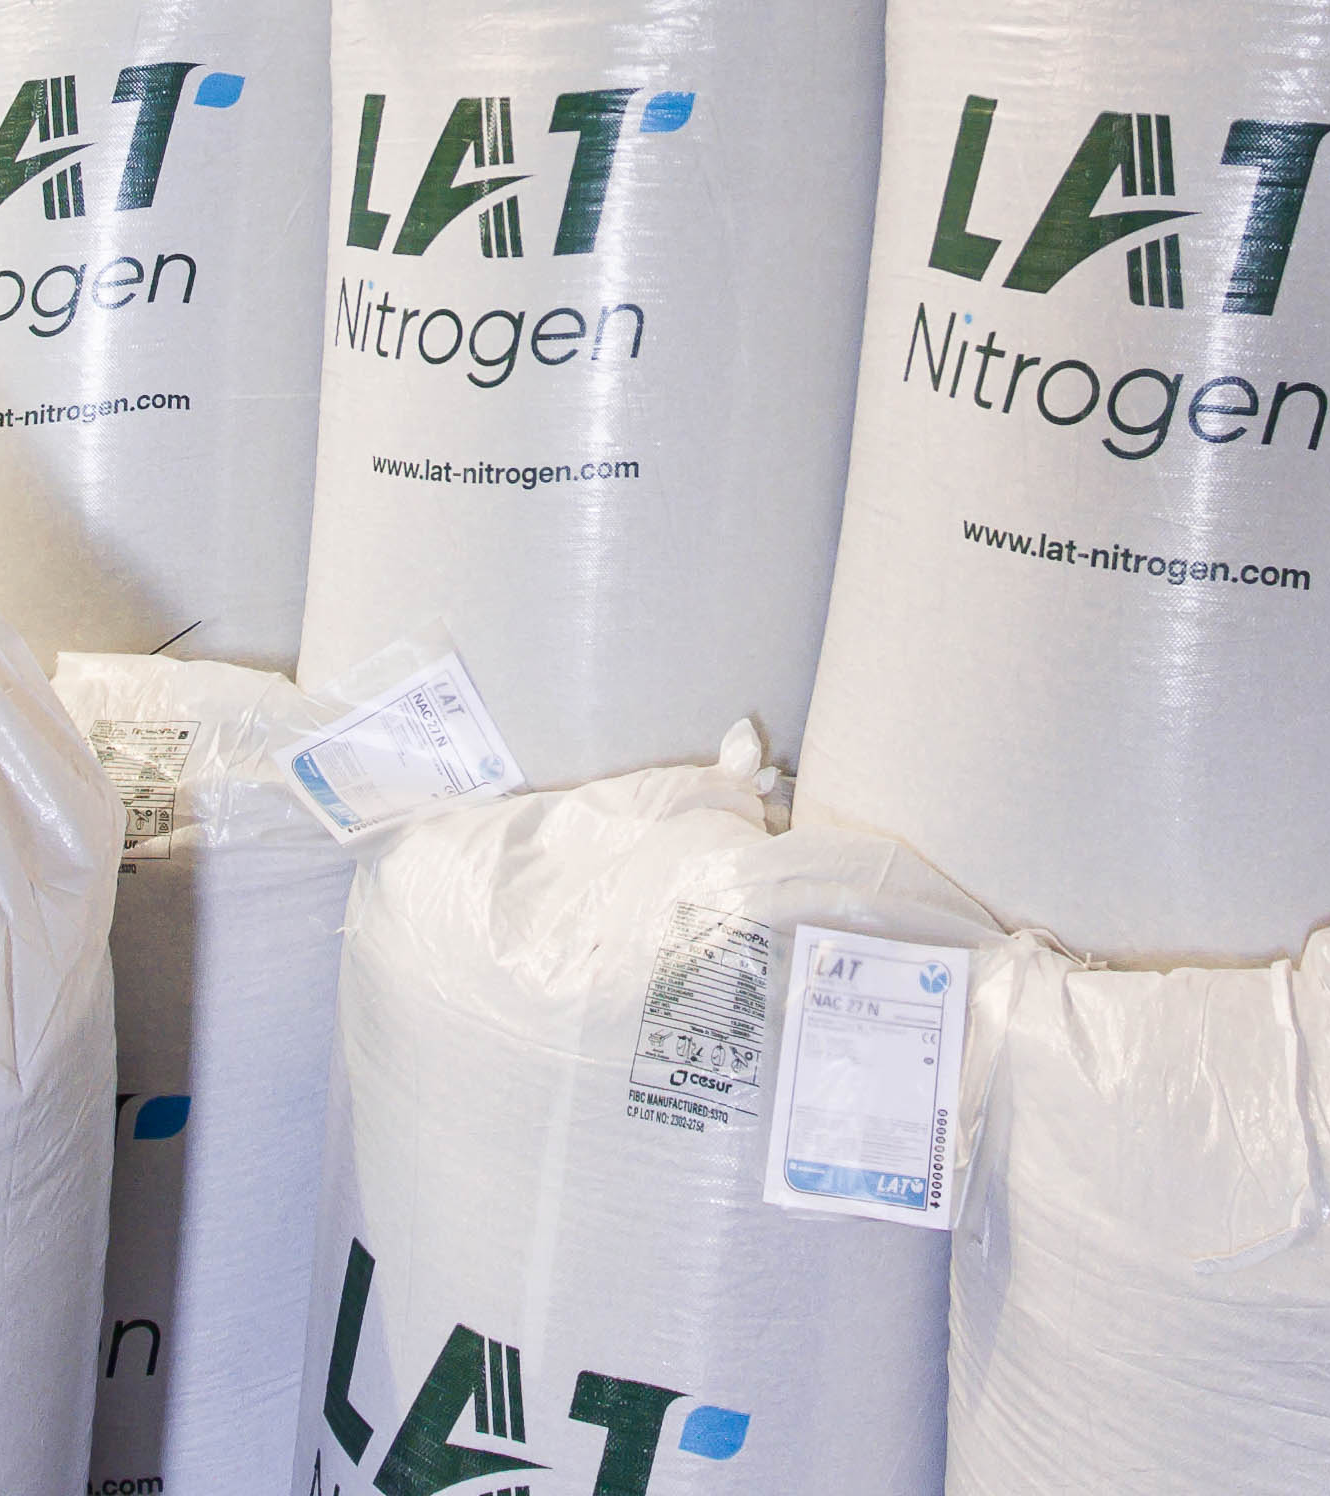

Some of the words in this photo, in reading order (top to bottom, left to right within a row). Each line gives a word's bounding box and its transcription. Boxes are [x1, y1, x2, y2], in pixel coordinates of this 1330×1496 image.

[346, 87, 645, 259] LAT
[335, 276, 645, 389] Nitrogen
[903, 302, 1329, 460] Nitrogen
[373, 455, 640, 490] www.lat-nitrogen.com
[962, 519, 1312, 591] www.lat-nitrogen.com
[815, 958, 863, 983] LAT
[811, 992, 841, 1010] NAC
[845, 997, 864, 1014] 27
[866, 1000, 881, 1018] N
[628, 1088, 646, 1105] FIBC
[689, 1073, 734, 1094] cesur
[639, 1107, 655, 1122] LOT
